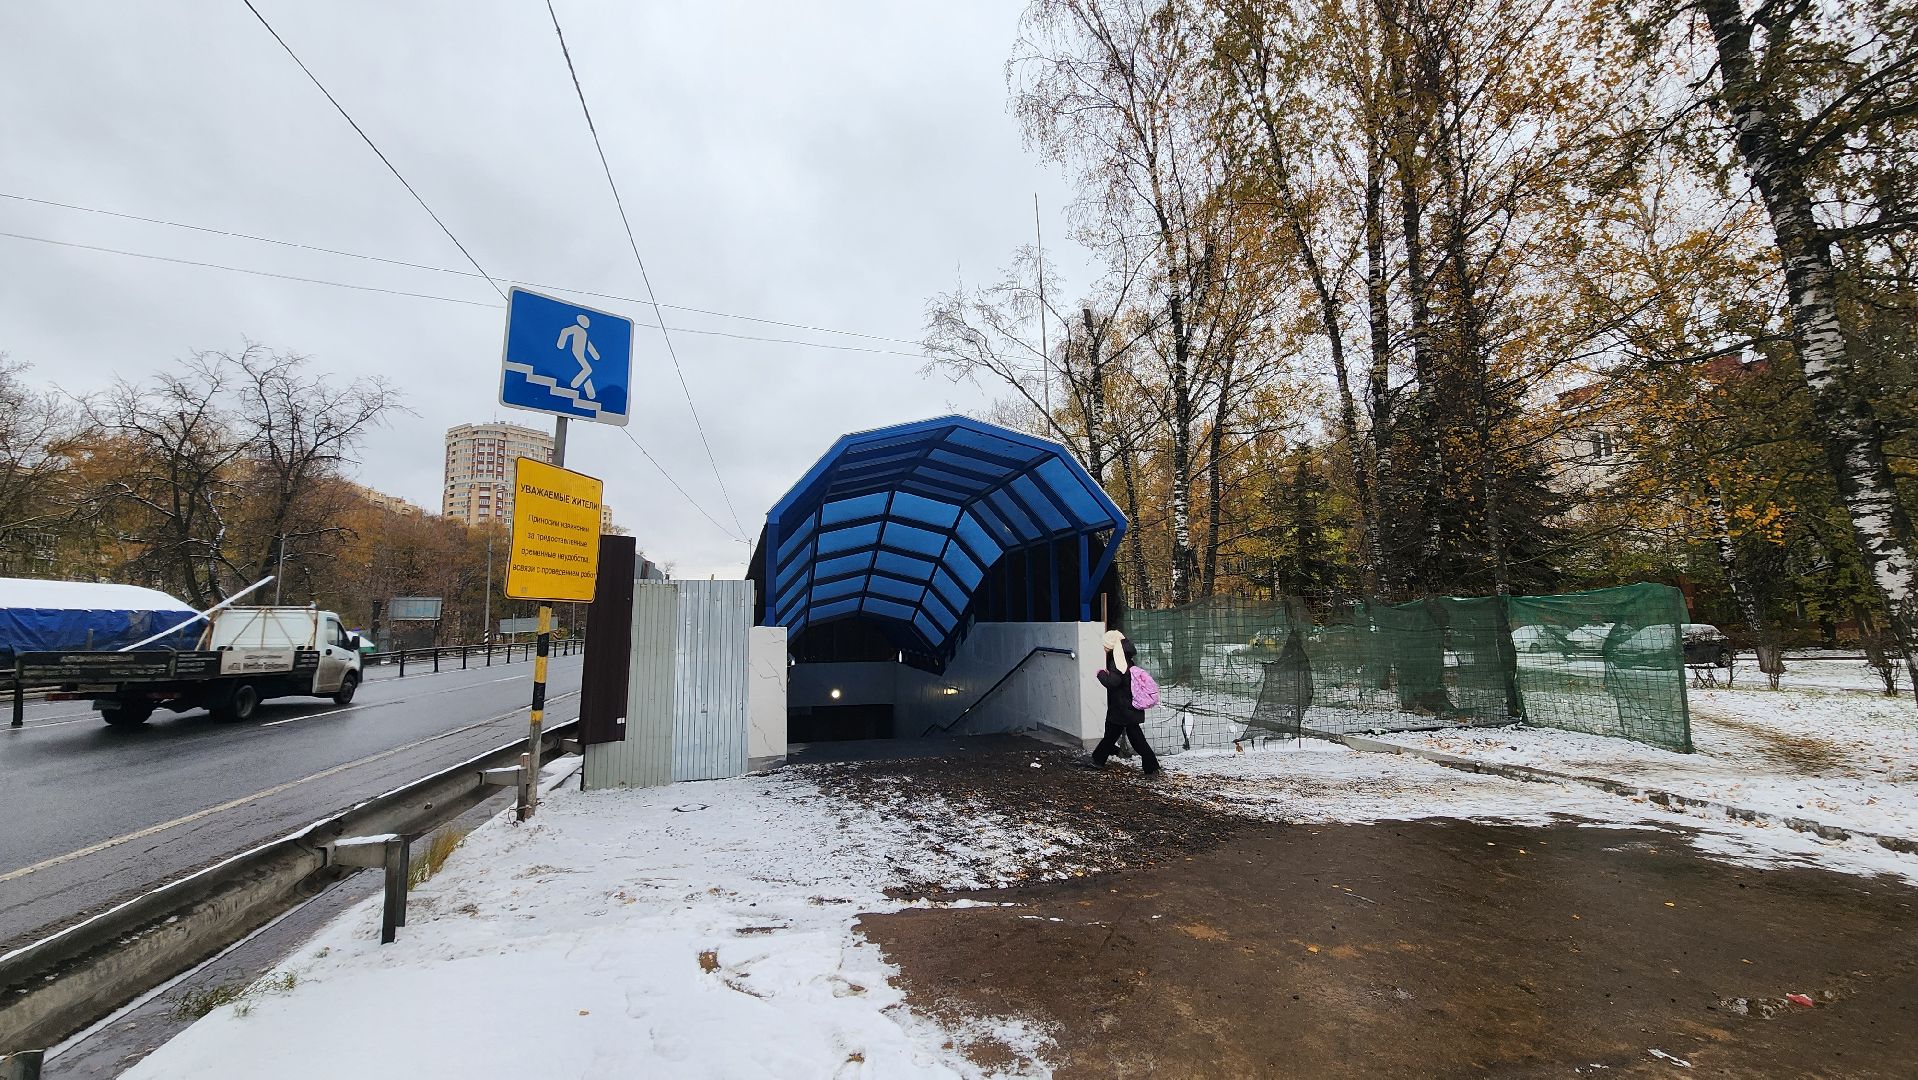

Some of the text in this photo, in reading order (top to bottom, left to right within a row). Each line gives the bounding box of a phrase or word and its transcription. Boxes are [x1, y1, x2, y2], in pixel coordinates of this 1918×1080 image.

[520, 483, 570, 504] УВАЖАЕМЫЕ
[528, 514, 560, 527] Приносим
[527, 532, 535, 540] за
[521, 548, 557, 559] временные
